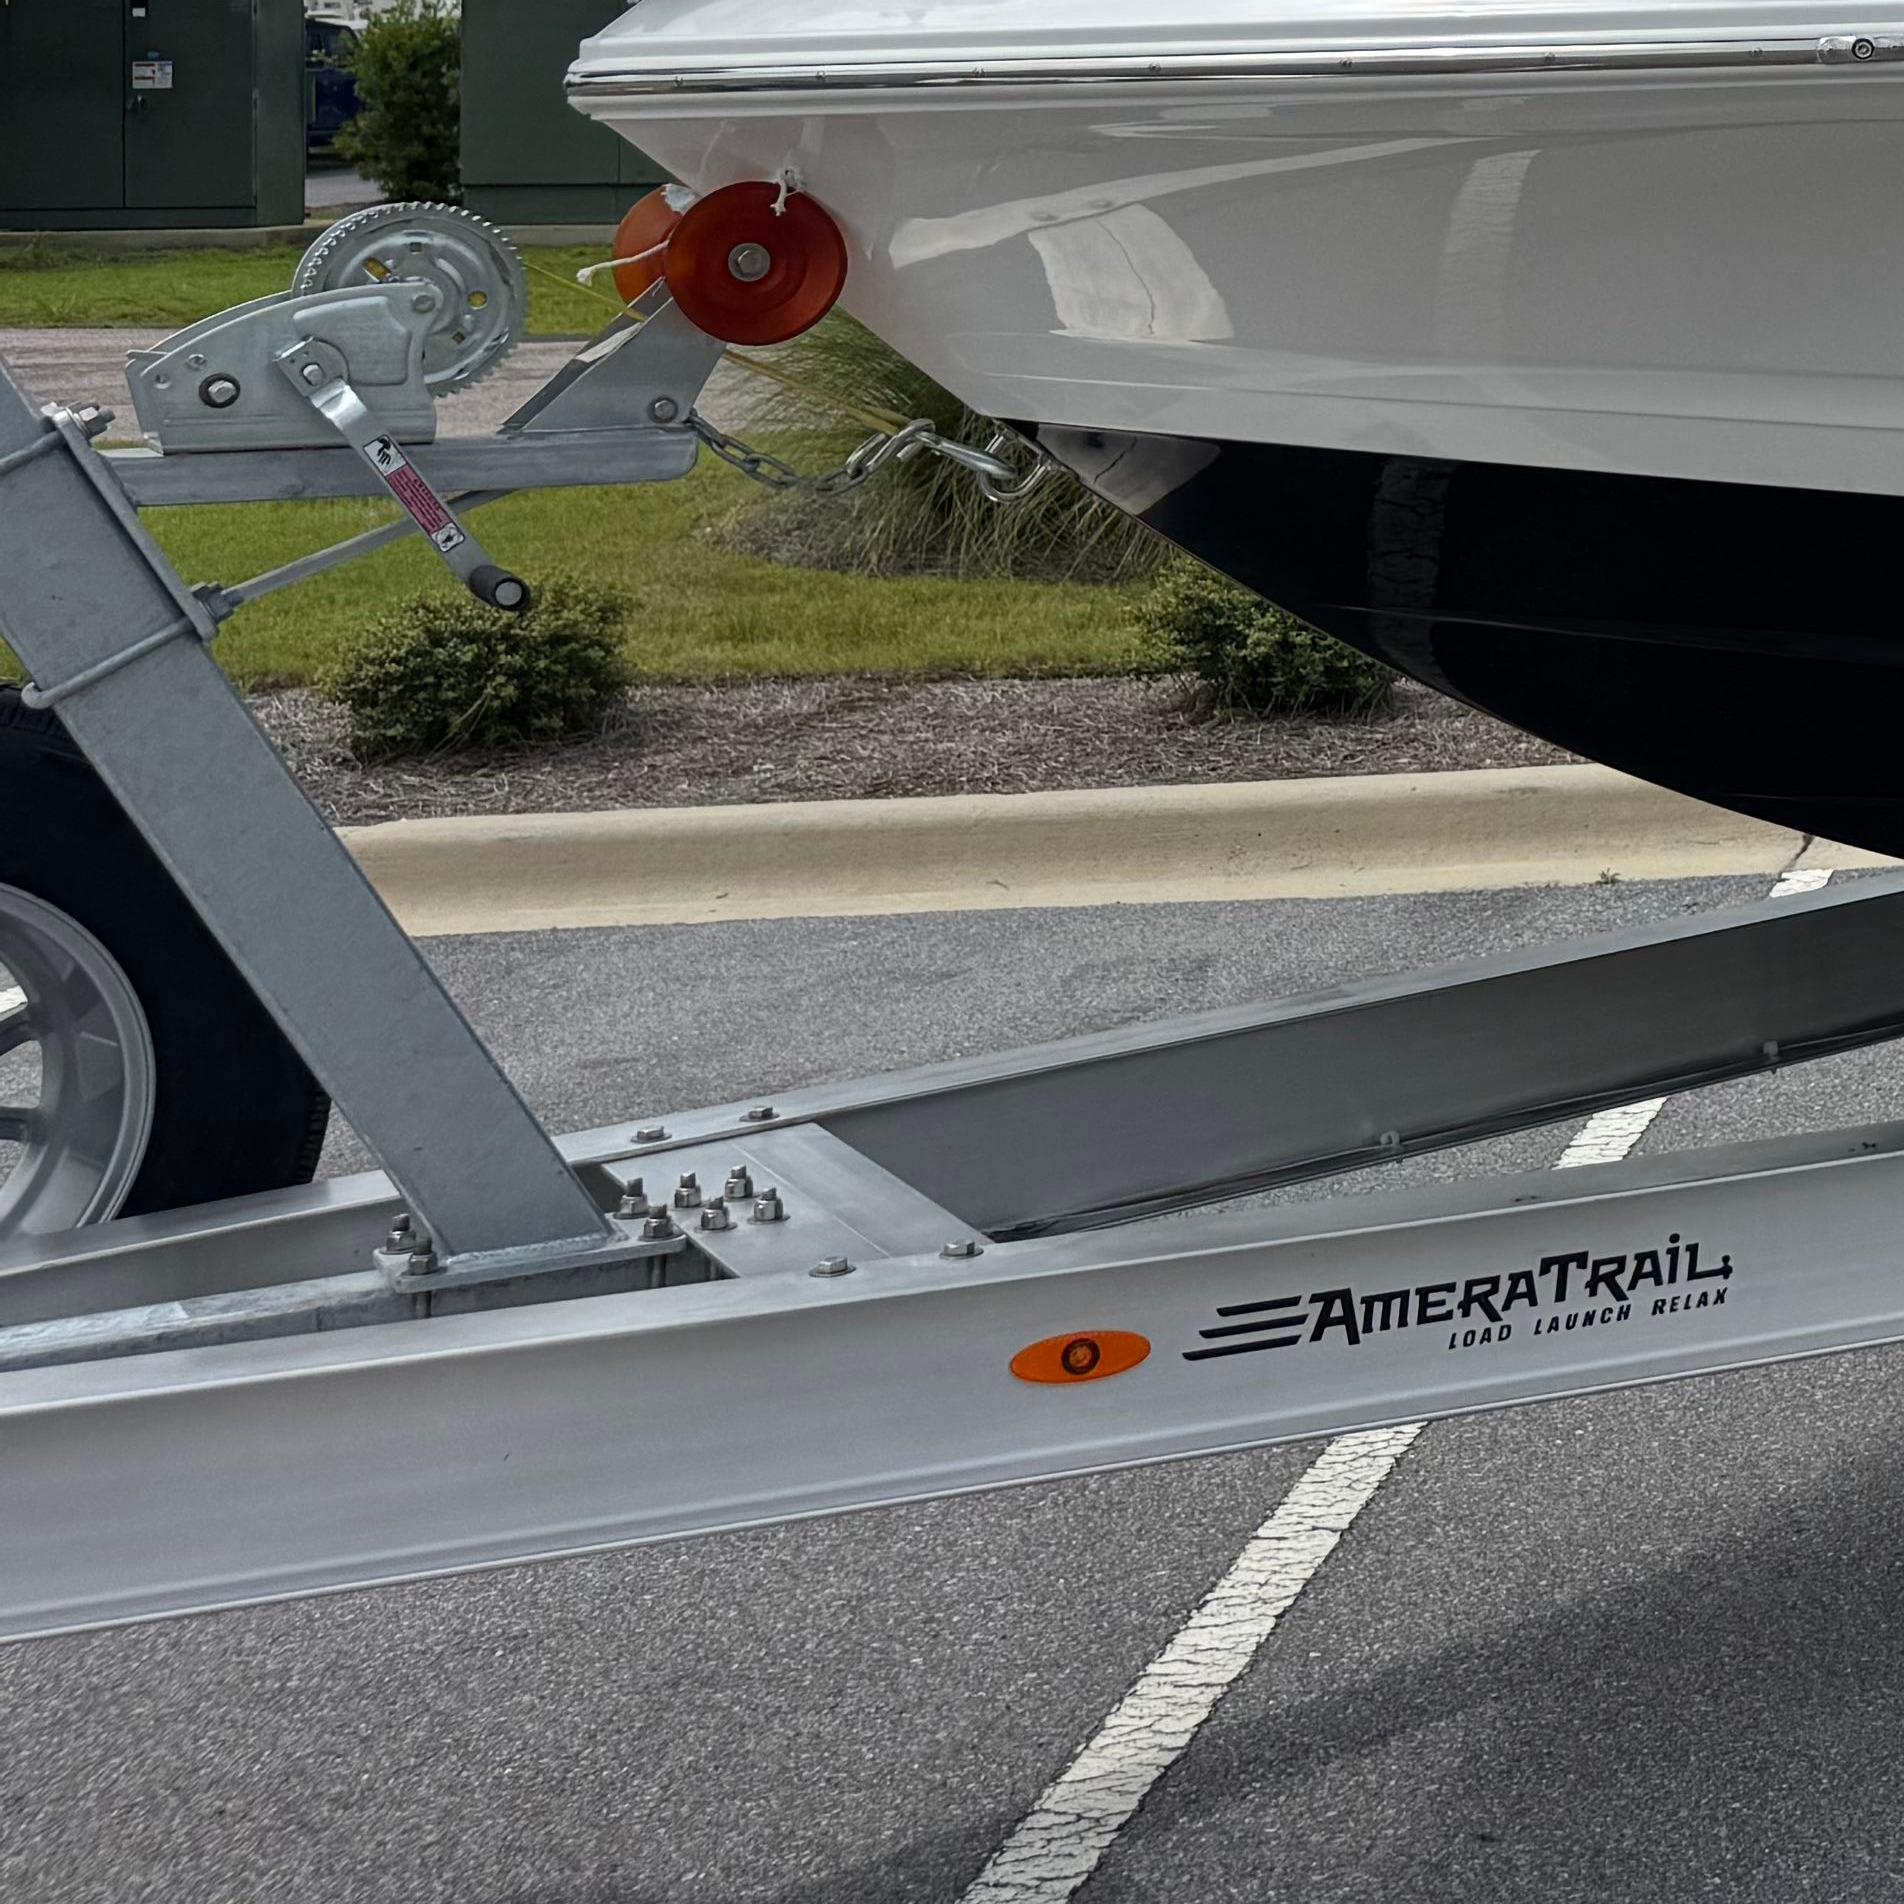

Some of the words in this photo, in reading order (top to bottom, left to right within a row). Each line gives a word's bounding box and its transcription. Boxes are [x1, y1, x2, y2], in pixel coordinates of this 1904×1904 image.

[1448, 1324, 1512, 1350] LOAD
[1534, 1303, 1632, 1337] LAUNCH
[1652, 1287, 1728, 1317] RELAX
